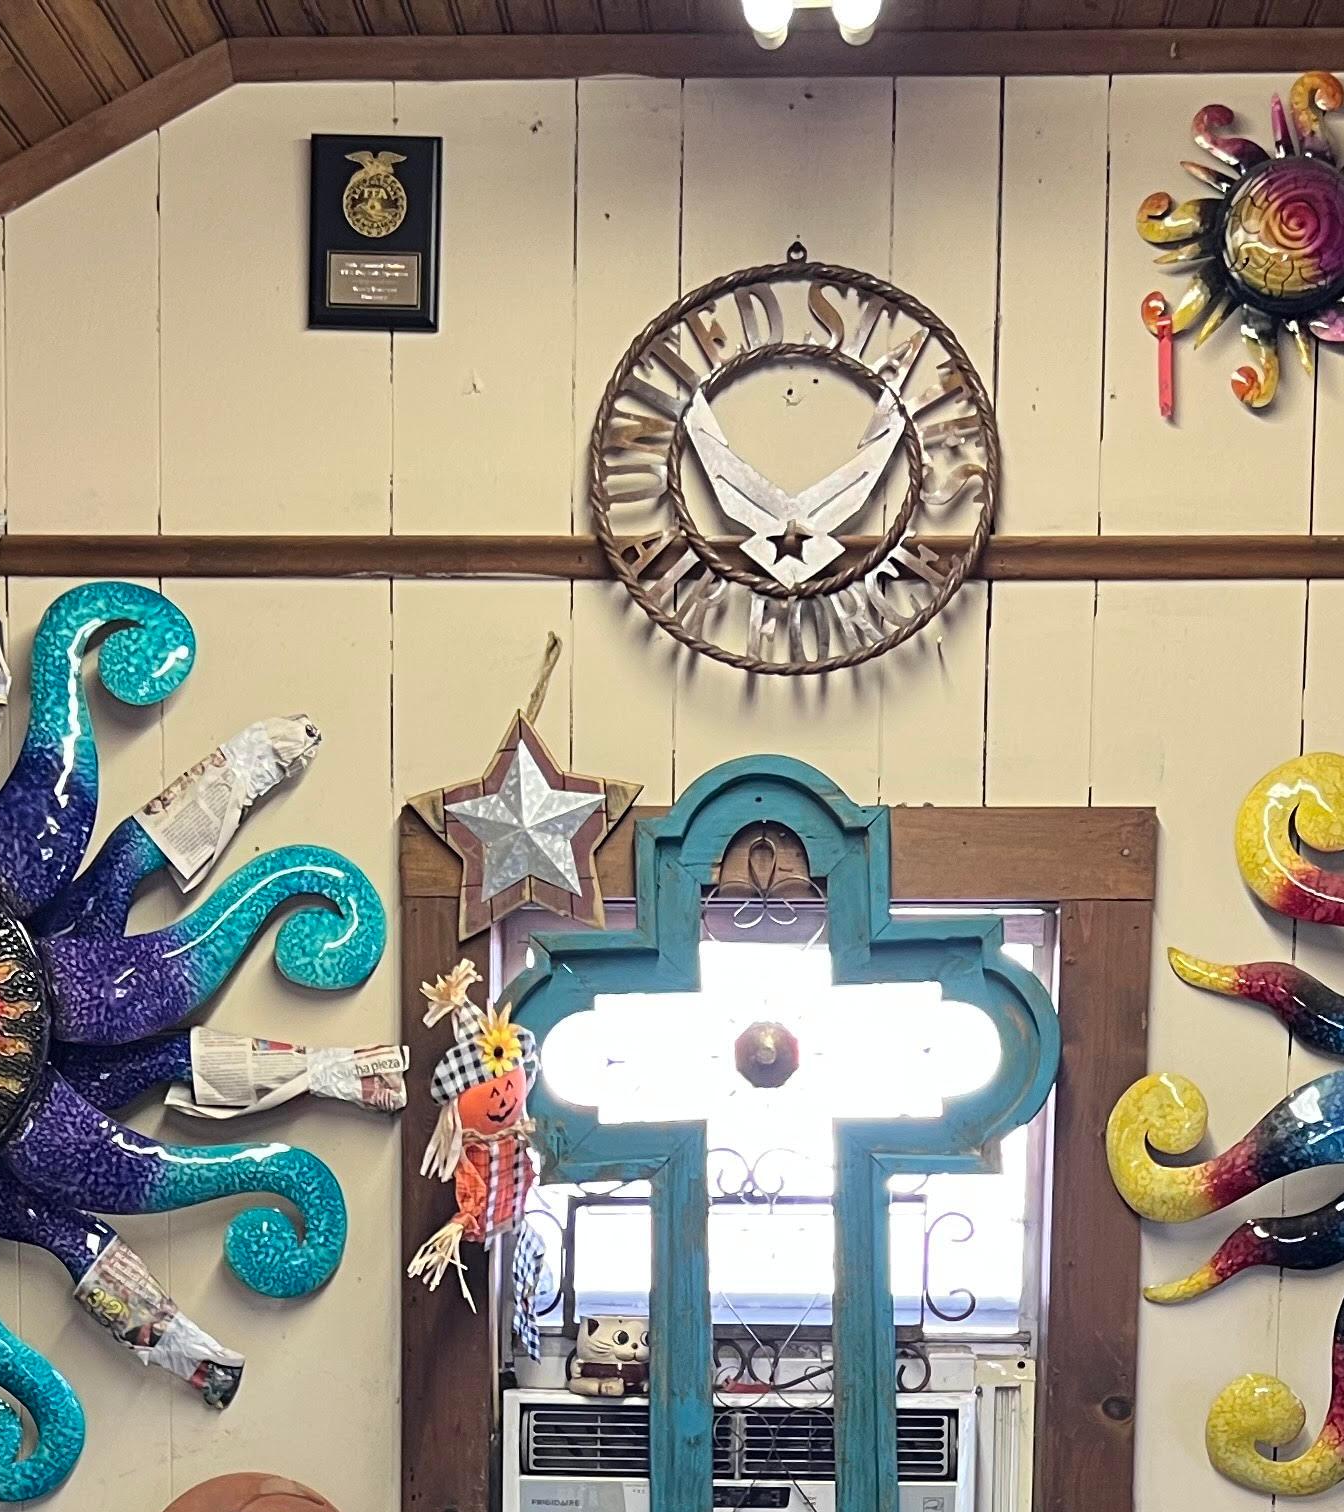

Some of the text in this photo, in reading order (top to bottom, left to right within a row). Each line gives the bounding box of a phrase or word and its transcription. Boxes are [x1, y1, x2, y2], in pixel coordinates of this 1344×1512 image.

[363, 188, 387, 199] FFA
[602, 281, 988, 511] UNITED STATES
[620, 518, 955, 664] AIR FORCE
[531, 1498, 579, 1506] FRIGIDAIRE
